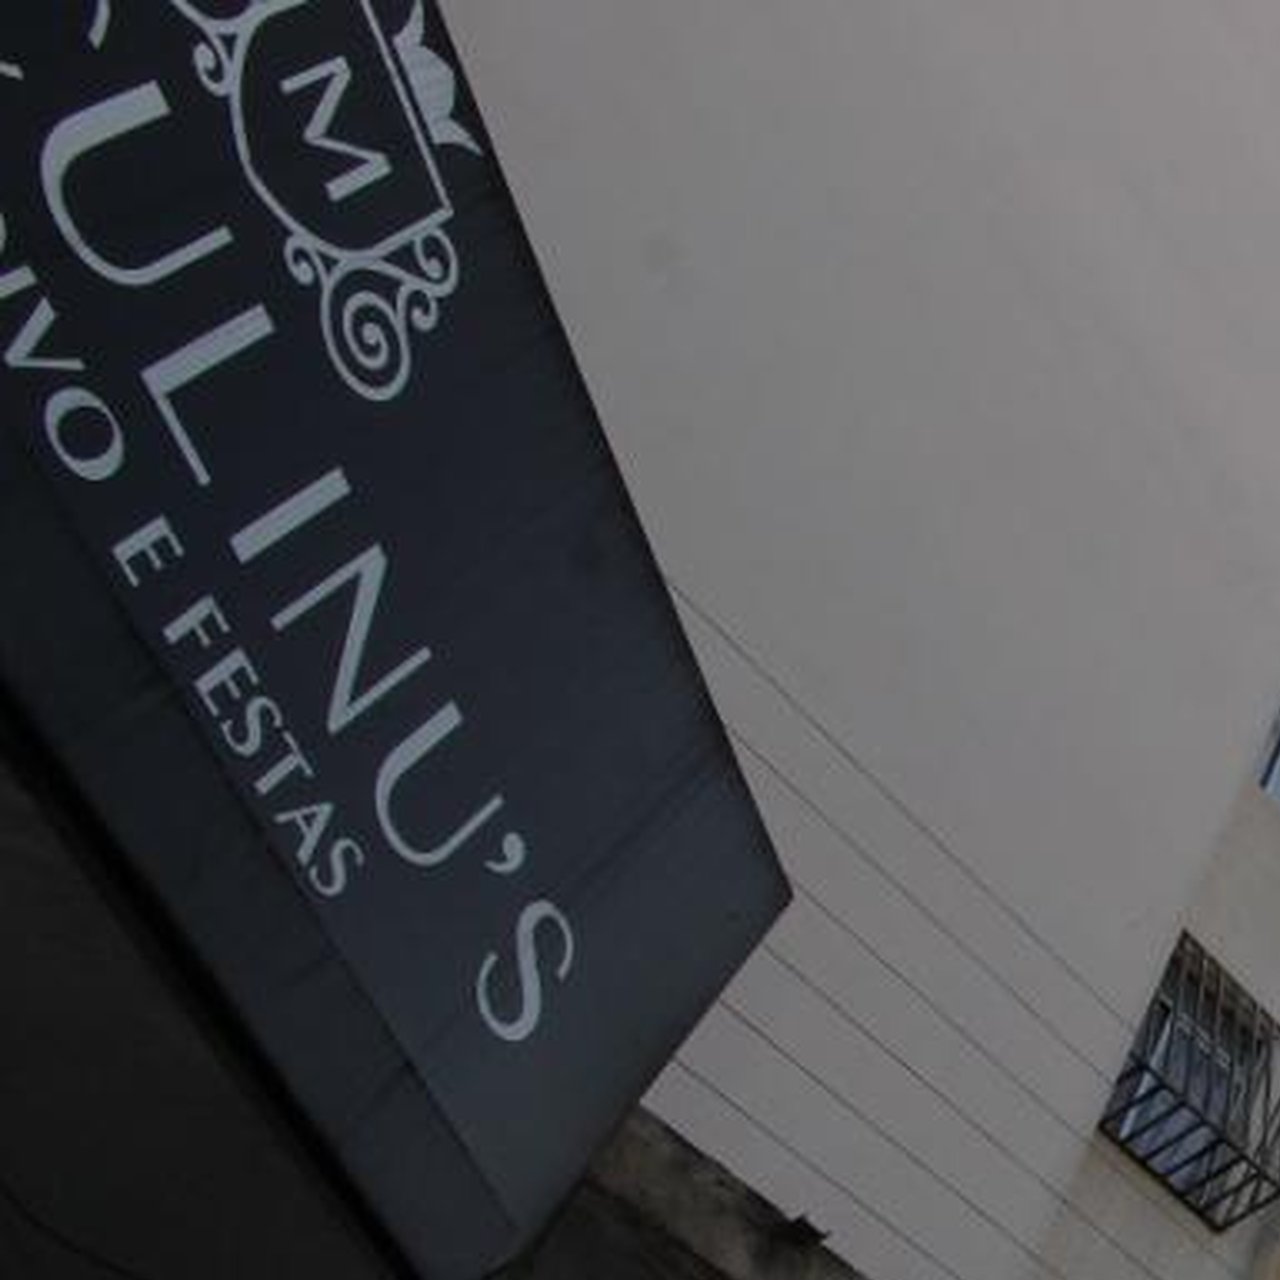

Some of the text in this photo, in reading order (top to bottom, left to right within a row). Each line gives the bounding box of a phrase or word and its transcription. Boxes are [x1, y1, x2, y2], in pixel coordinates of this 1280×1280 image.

[0, 0, 574, 1042] ULINU'S
[112, 515, 185, 588] E
[163, 597, 366, 898] FESTAS
